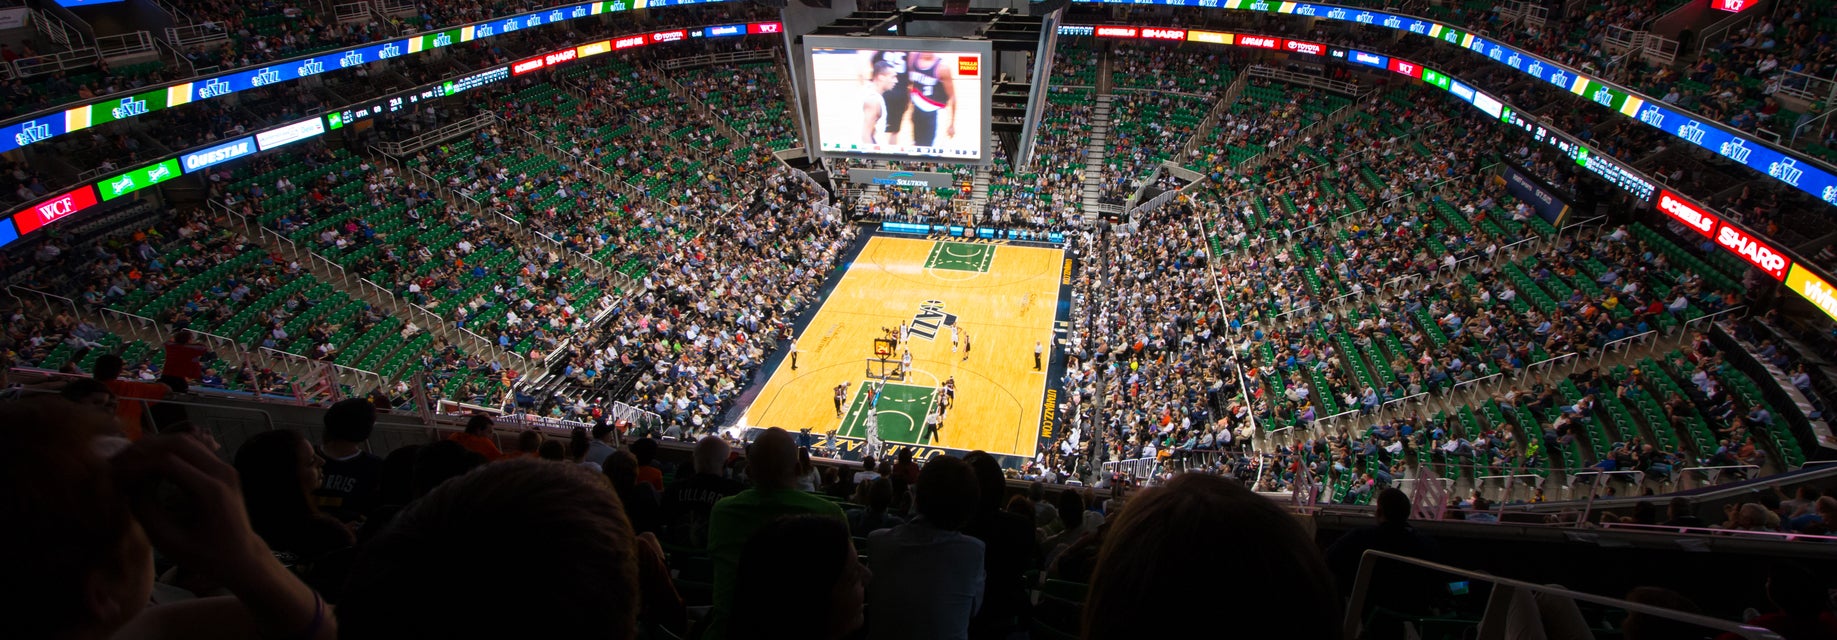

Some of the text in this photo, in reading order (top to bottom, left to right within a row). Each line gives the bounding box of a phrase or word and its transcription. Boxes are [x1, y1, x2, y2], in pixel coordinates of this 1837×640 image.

[662, 31, 683, 39] TOYOTA
[1142, 29, 1185, 40] SHARP
[1297, 43, 1320, 52] TOYOTA
[546, 49, 576, 65] SHARP
[356, 109, 368, 118] UTA
[39, 197, 72, 220] WCF
[1660, 195, 1713, 232] SCHEELS
[1718, 225, 1785, 276] SHARP
[1041, 389, 1057, 438] UTAHJAZZ.COM
[883, 443, 946, 462] UTH
